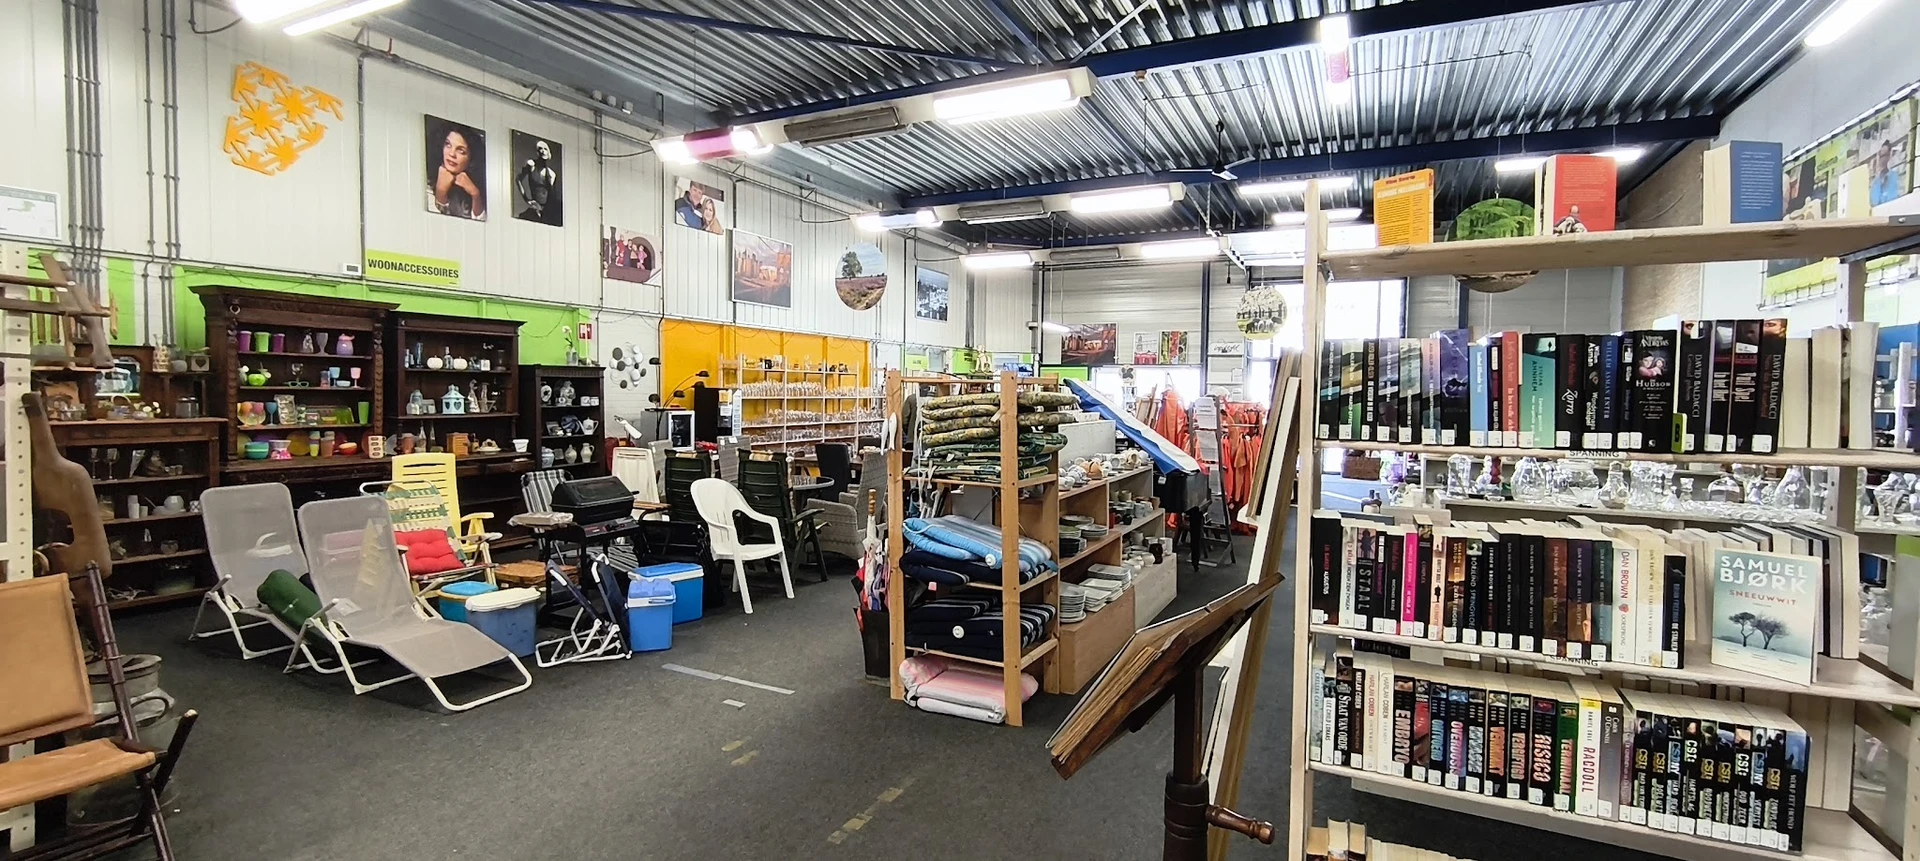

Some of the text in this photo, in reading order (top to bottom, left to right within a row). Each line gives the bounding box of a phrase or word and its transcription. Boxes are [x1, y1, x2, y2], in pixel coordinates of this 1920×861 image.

[368, 259, 459, 279] WOONACCESSOIRES
[1588, 342, 1596, 367] Asman
[1507, 361, 1515, 382] Archer
[1692, 354, 1703, 418] DAVID BALDACCI
[1732, 387, 1756, 402] Spel
[1768, 354, 1782, 419] DAVID BALDACCI
[1562, 389, 1578, 415] Zorro
[1621, 552, 1630, 567] DAN
[1721, 555, 1808, 578] SAMUEL
[1322, 571, 1330, 595] AUGUSTUS
[1358, 569, 1372, 609] STAAL
[1621, 569, 1630, 598] BROWN
[1720, 567, 1808, 593] BJØRK
[1729, 589, 1796, 605] SNEEUWWIT
[1338, 695, 1351, 751] STAAT VAN ORDE
[1394, 709, 1411, 764] EMBRYO
[1431, 719, 1444, 761] ONTVOERD
[1449, 721, 1464, 775] OVERDOSIS
[1468, 726, 1483, 773] INVASIE
[1686, 740, 1697, 763] CSI:
[1511, 732, 1526, 780] VERGIFTIGD
[1533, 734, 1552, 782] RISICO
[1559, 738, 1573, 794] TERMINAAL
[1582, 746, 1596, 793] RAGDOLL
[1638, 748, 1648, 769] CSI:
[1656, 752, 1665, 773] CSI:
[1704, 758, 1714, 779] CSI:
[1738, 753, 1750, 776] CSI:
[1721, 762, 1731, 783] CSI:
[1771, 768, 1780, 790] CSI:
[1687, 778, 1696, 811] HARTSLAG
[1722, 791, 1730, 823] ONDERSTROO
[1738, 790, 1748, 824] OUD ZEER
[1753, 799, 1762, 827] VERMIST
[1769, 798, 1779, 830] ZONDVLOE
